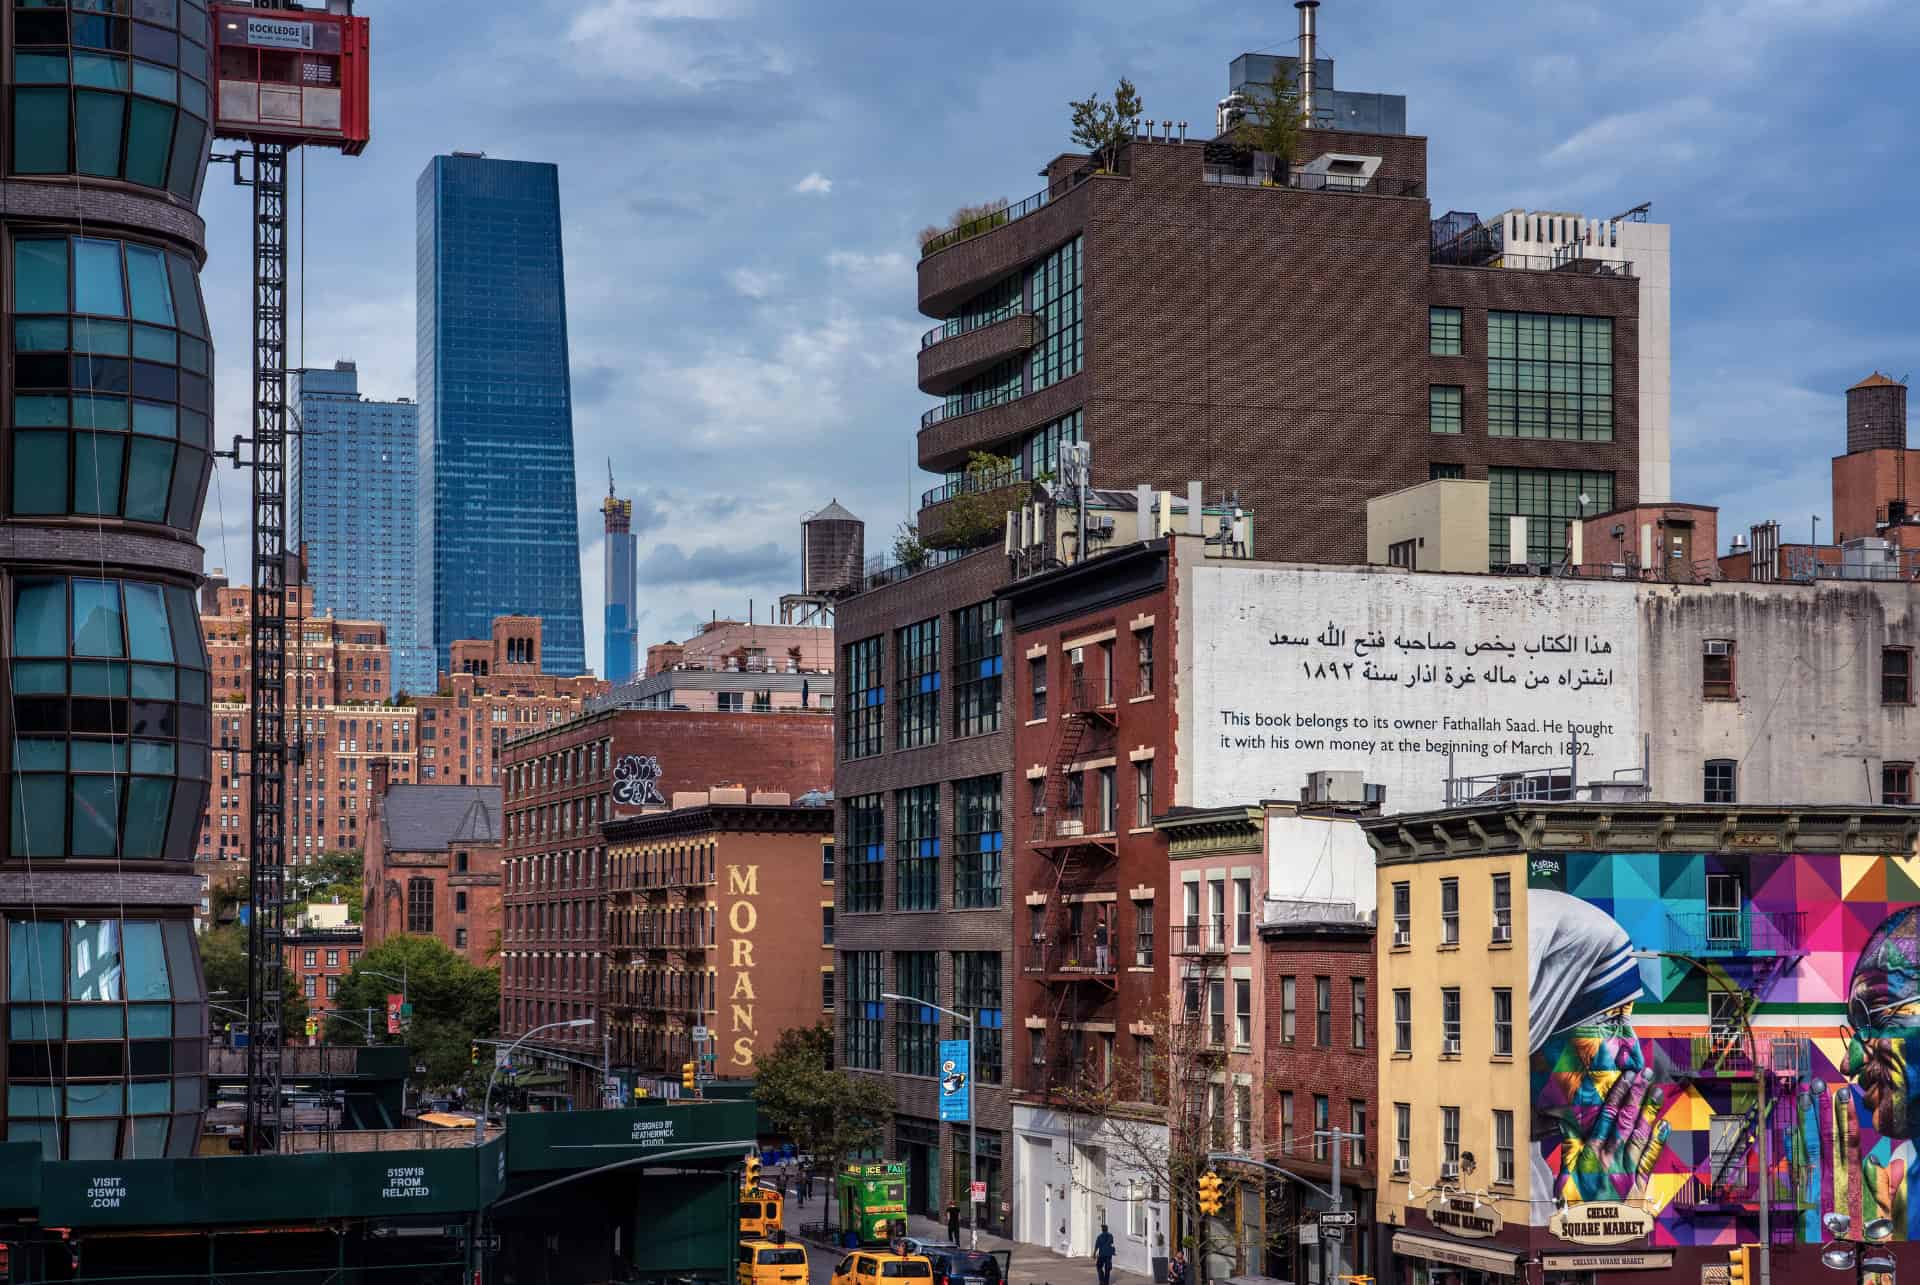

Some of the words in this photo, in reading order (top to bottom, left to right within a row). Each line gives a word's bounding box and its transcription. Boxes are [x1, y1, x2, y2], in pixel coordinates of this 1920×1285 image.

[249, 23, 300, 36] ROCKLEDGE
[1269, 631, 1309, 646] سعد
[1317, 620, 1345, 647] الله
[1354, 629, 1385, 657] فتح
[1394, 631, 1457, 655] صاحبه
[1465, 634, 1516, 657] يخص
[1525, 634, 1577, 660] الكتاب
[1585, 635, 1612, 654] هذا
[1303, 661, 1354, 681] ١٨٩٢
[1362, 661, 1398, 681] سنة
[1405, 663, 1437, 688] اذار
[1445, 666, 1475, 688] غرة
[1483, 665, 1516, 684] ماله
[1525, 670, 1549, 689] من
[1558, 667, 1613, 690] اشتراه
[1221, 711, 1250, 726] This
[1256, 712, 1292, 727] book
[1296, 713, 1348, 731] belongs
[1353, 716, 1368, 728] to
[1373, 715, 1389, 729] its
[1394, 718, 1437, 731] owner
[1443, 716, 1501, 731] Fathallah
[1506, 718, 1540, 733] Saad.
[1543, 719, 1563, 733] He
[1567, 720, 1614, 738] bought
[1220, 734, 1231, 749] it
[1234, 735, 1265, 749] with
[1271, 735, 1289, 749] his
[1294, 740, 1324, 750] own
[1329, 740, 1376, 755] money
[1381, 740, 1394, 751] at
[1398, 739, 1421, 752] the
[1425, 739, 1489, 757] beginning
[1493, 740, 1507, 754] of
[1511, 741, 1553, 755] March
[1559, 743, 1594, 757] 1892.
[387, 1167, 425, 1177] 515W18
[92, 1177, 121, 1187] VISIT
[390, 1178, 421, 1187] FROM
[87, 1188, 126, 1197] 515W18
[382, 1187, 430, 1198] RELATED
[91, 1198, 120, 1208] .COM
[1586, 1207, 1619, 1219] CHELSEA
[1561, 1221, 1601, 1237] SQUARE
[1603, 1221, 1645, 1235] MARKET
